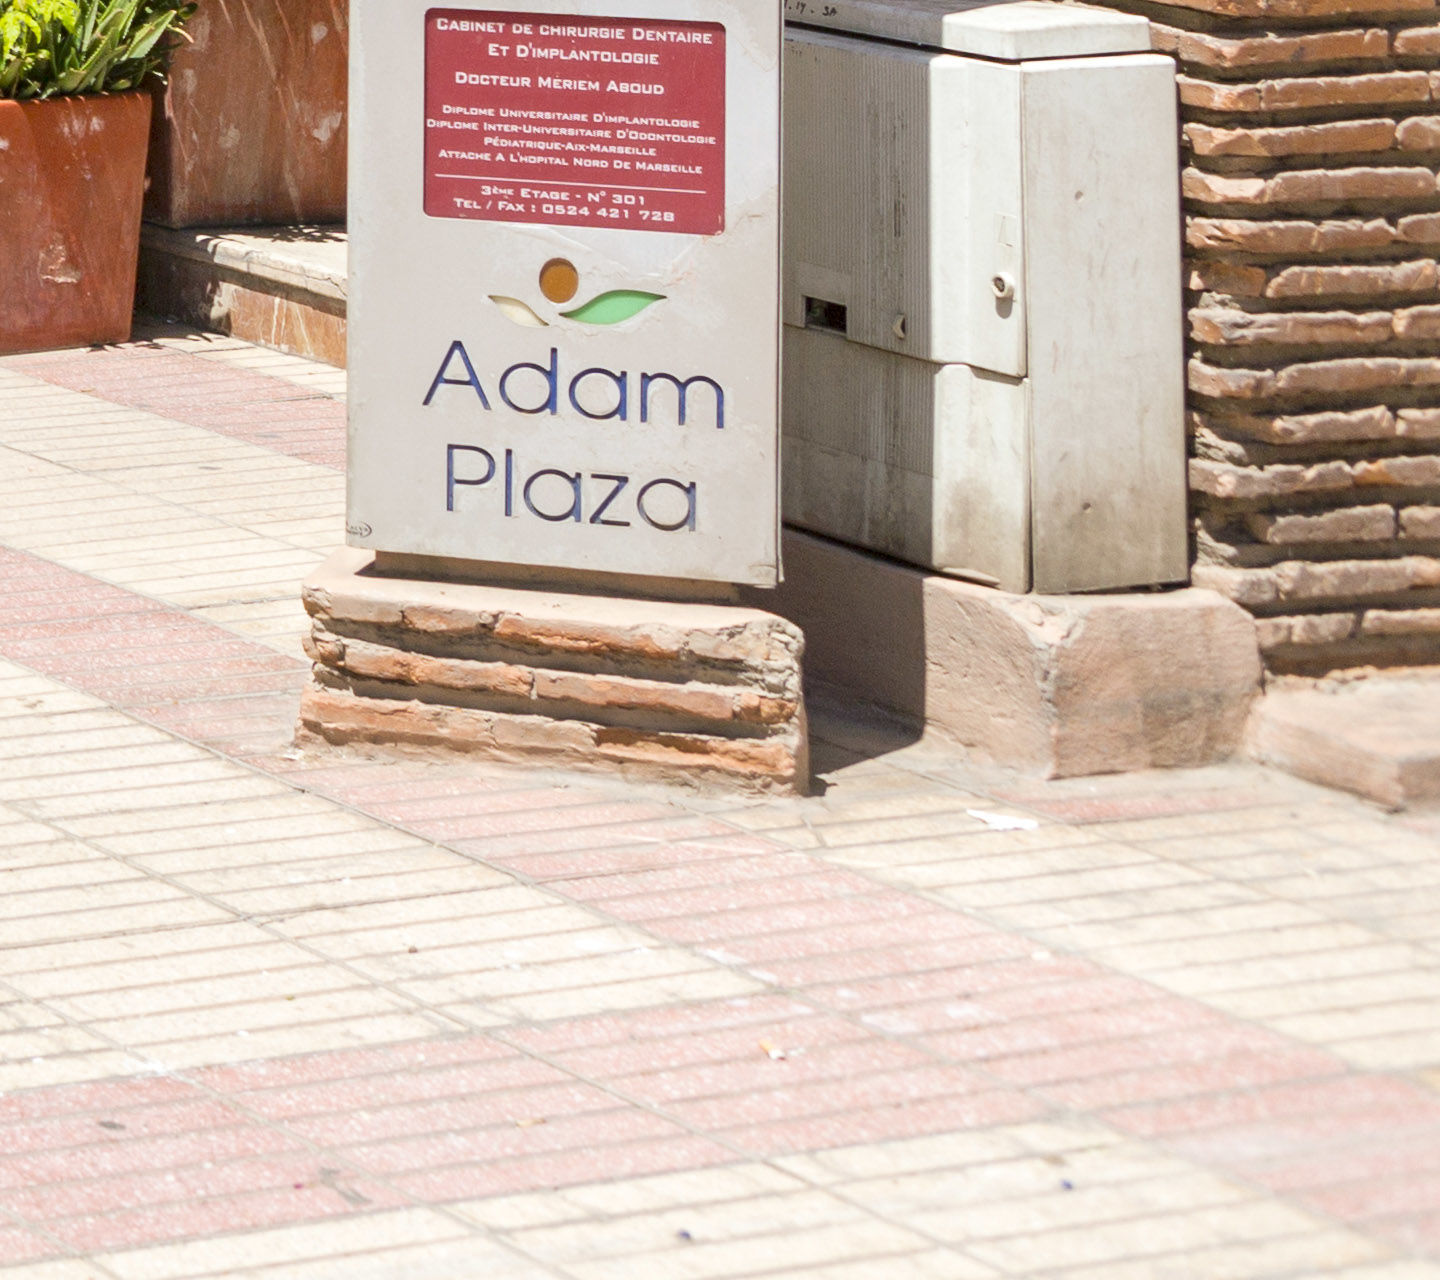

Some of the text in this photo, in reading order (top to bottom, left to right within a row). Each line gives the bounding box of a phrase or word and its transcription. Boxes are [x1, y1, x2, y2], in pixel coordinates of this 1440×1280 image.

[542, 204, 630, 219] 0524 421
[422, 340, 724, 428] Adam
[446, 444, 696, 531] Plaza
